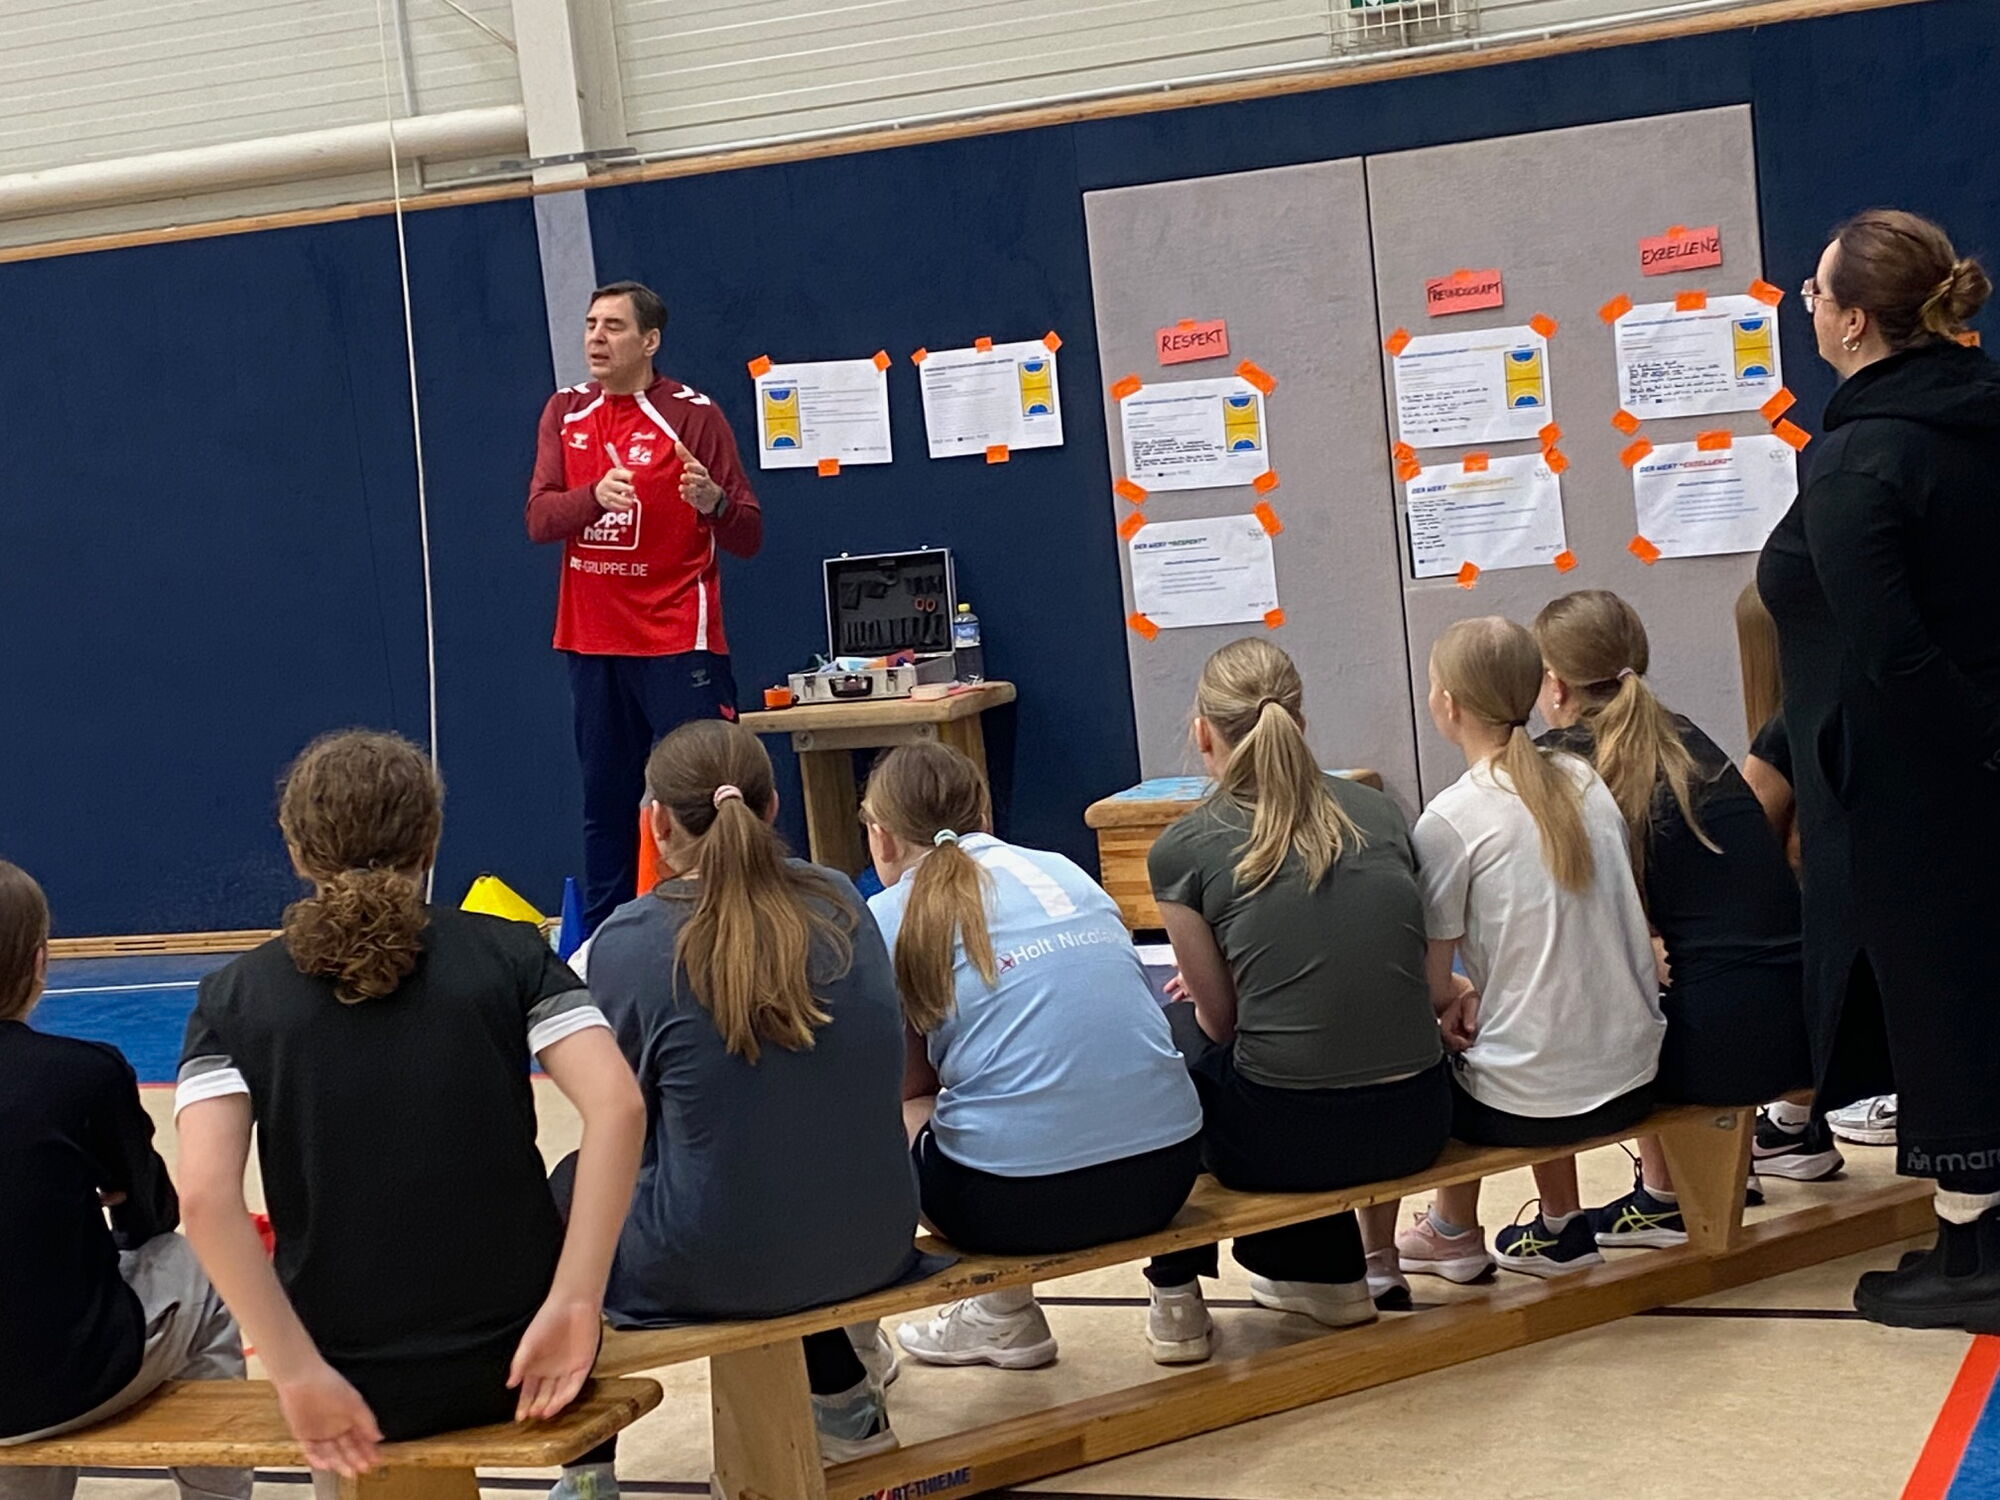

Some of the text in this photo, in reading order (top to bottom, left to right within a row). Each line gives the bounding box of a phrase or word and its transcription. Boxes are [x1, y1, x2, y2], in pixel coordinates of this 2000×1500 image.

[1161, 328, 1223, 352] RESPEKT
[583, 526, 620, 542] herz
[1009, 938, 1055, 965] Holt
[1935, 1148, 2000, 1172] mar
